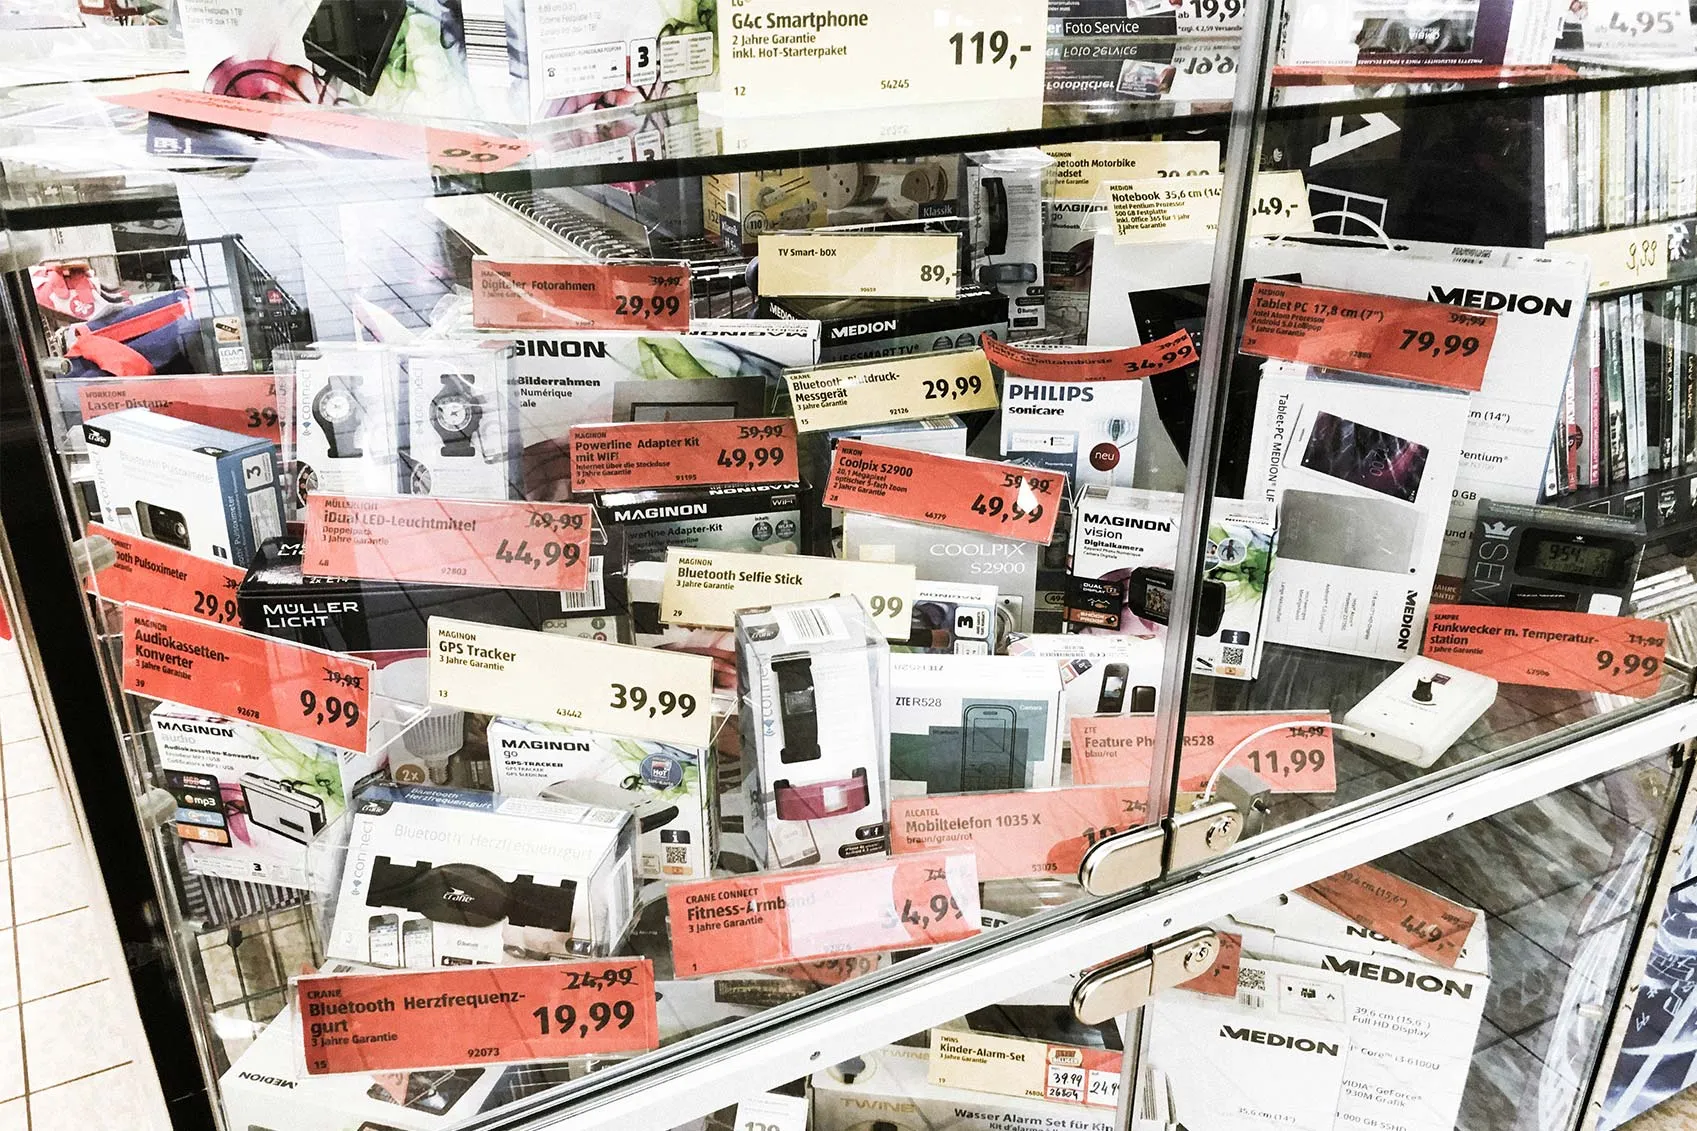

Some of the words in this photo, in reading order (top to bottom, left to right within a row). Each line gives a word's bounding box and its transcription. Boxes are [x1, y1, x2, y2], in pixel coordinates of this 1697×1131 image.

[732, 13, 762, 30] G4c
[766, 11, 868, 31] Smartphone
[1065, 22, 1091, 34] Foto
[1094, 20, 1140, 34] Service
[741, 34, 769, 46] Jahre
[772, 32, 816, 44] Garantie
[732, 47, 755, 58] inkl.
[758, 45, 848, 58] HoT-Starterpaket
[949, 30, 1031, 70] 119,-
[734, 86, 746, 96] 12
[880, 79, 910, 90] 54245
[1091, 159, 1136, 168] Motorbike
[1112, 190, 1160, 202] Notebook
[1165, 190, 1185, 200] 35,6
[1188, 190, 1202, 198] cm
[923, 206, 952, 217] Klassik
[1128, 202, 1154, 210] Pentium
[1155, 201, 1185, 209] Prozessor
[1136, 207, 1167, 217] Festplatte
[749, 219, 762, 230] 110
[1130, 215, 1149, 223] Office
[1140, 221, 1166, 229] Garantie
[778, 249, 788, 257] TV
[790, 248, 818, 257] Smart-
[920, 265, 960, 286] 89,-
[532, 280, 595, 291] Fotorahmen
[615, 296, 680, 316] 29,99
[1428, 286, 1573, 318] MEDION
[1256, 297, 1292, 311] Tablet
[1294, 301, 1308, 312] PC
[1313, 304, 1338, 317] 17,8
[1340, 307, 1358, 318] cm
[1360, 309, 1384, 322] (7")
[831, 320, 899, 339] MEDION
[517, 340, 606, 358] GINON
[1400, 329, 1480, 357] 79,99
[1124, 346, 1192, 373] 34,99
[518, 376, 600, 388] Bilderrahmen
[923, 375, 982, 400] 29,99
[521, 388, 573, 399] Numérique
[795, 388, 848, 404] Messgerät
[1009, 385, 1094, 402] PHILIPS
[88, 399, 173, 411] Laser-Distanz-
[803, 402, 820, 411] Jahre
[820, 399, 848, 409] Garantie
[889, 407, 909, 415] 92126
[1008, 405, 1064, 416] sonicare
[1272, 394, 1289, 442] Tablet-PC
[740, 425, 785, 440] 59,99
[575, 440, 632, 451] Powerline
[637, 439, 682, 450] Adapter
[684, 437, 700, 447] Kit
[576, 453, 594, 462] mit
[842, 447, 863, 456] NIKON
[1094, 451, 1115, 461] neu
[636, 460, 671, 469] Steckdose
[717, 447, 785, 471] 49,99
[839, 456, 878, 472] Coolpix
[880, 463, 913, 477] S2900
[851, 470, 887, 483] Megapixel
[889, 484, 908, 494] Zoom
[1461, 490, 1476, 500] GB
[614, 504, 708, 521] MAGINON
[925, 511, 947, 521] 46379
[363, 513, 477, 532] LED-Leuchtmittel
[1084, 513, 1171, 532] MAGINON
[1084, 527, 1123, 540] vision
[930, 542, 1025, 559] COOLPIX
[1084, 539, 1144, 552] Digitalkamera
[496, 539, 581, 568] 44,99
[134, 556, 188, 582] Pulsoximeter
[679, 558, 713, 567] MAGINON
[970, 562, 1025, 574] S2900
[678, 567, 736, 582] Bluetooth
[738, 571, 772, 583] Selfie
[775, 573, 803, 586] Stick
[682, 581, 701, 590] Jahre
[703, 582, 735, 592] Garantie
[264, 601, 359, 615] MÜLLER
[673, 610, 682, 618] 29
[266, 616, 329, 628] LICHT
[1397, 590, 1418, 650] MEDION
[439, 629, 477, 642] MAGINON
[1430, 635, 1469, 646] station
[1432, 623, 1501, 636] Funkwecker
[1504, 628, 1519, 637] m.
[1522, 628, 1599, 644] Temperatur-
[135, 629, 230, 663] Audiokassetten-
[439, 641, 463, 654] GPS
[467, 645, 516, 662] Tracker
[135, 644, 194, 670] Konverter
[446, 657, 467, 666] Jahre
[469, 660, 504, 671] Garantie
[1597, 650, 1659, 677] 9,99
[135, 679, 145, 688] 39
[439, 690, 448, 698] 13
[610, 684, 696, 718] 39,99
[896, 696, 911, 706] ZTE
[912, 697, 942, 707] R528
[237, 706, 260, 719] 92678
[300, 690, 360, 728] 9,99
[556, 708, 582, 719] 43442
[157, 721, 234, 738] MAGINON
[502, 739, 590, 751] MAGINON
[1085, 736, 1133, 748] Feature
[1085, 750, 1117, 758] blau/rot
[1248, 749, 1325, 777] 11,99
[403, 771, 420, 781] 2x
[905, 808, 940, 817] ALCATEL
[906, 818, 992, 833] Mobiltelefon
[996, 815, 1029, 828] 1035
[1032, 814, 1041, 825] X
[907, 833, 973, 844] braun/grau/rot
[1032, 863, 1058, 872] 53075
[686, 892, 716, 904] CRANE
[718, 888, 759, 901] CONNECT
[696, 921, 722, 934] Jahre
[723, 915, 764, 929] Garantie
[561, 966, 638, 990] 24,99
[1321, 955, 1473, 1000] MEDION
[309, 999, 395, 1017] Bluetooth
[404, 992, 525, 1011] Herzfrequenz-
[1355, 1006, 1377, 1019] 39,6
[533, 1001, 635, 1039] 19,99
[311, 1021, 348, 1038] gurt
[320, 1035, 349, 1047] Jahre
[352, 1032, 398, 1045] Garantie
[1220, 1025, 1339, 1057] MEDION
[467, 1047, 500, 1058] 92073
[940, 1043, 1025, 1062] Kinder-Alarm-Set
[954, 1108, 999, 1120] Wasser
[1003, 1113, 1041, 1125] Alarm
[1044, 1117, 1066, 1128] Set
[1069, 1119, 1090, 1130] für
